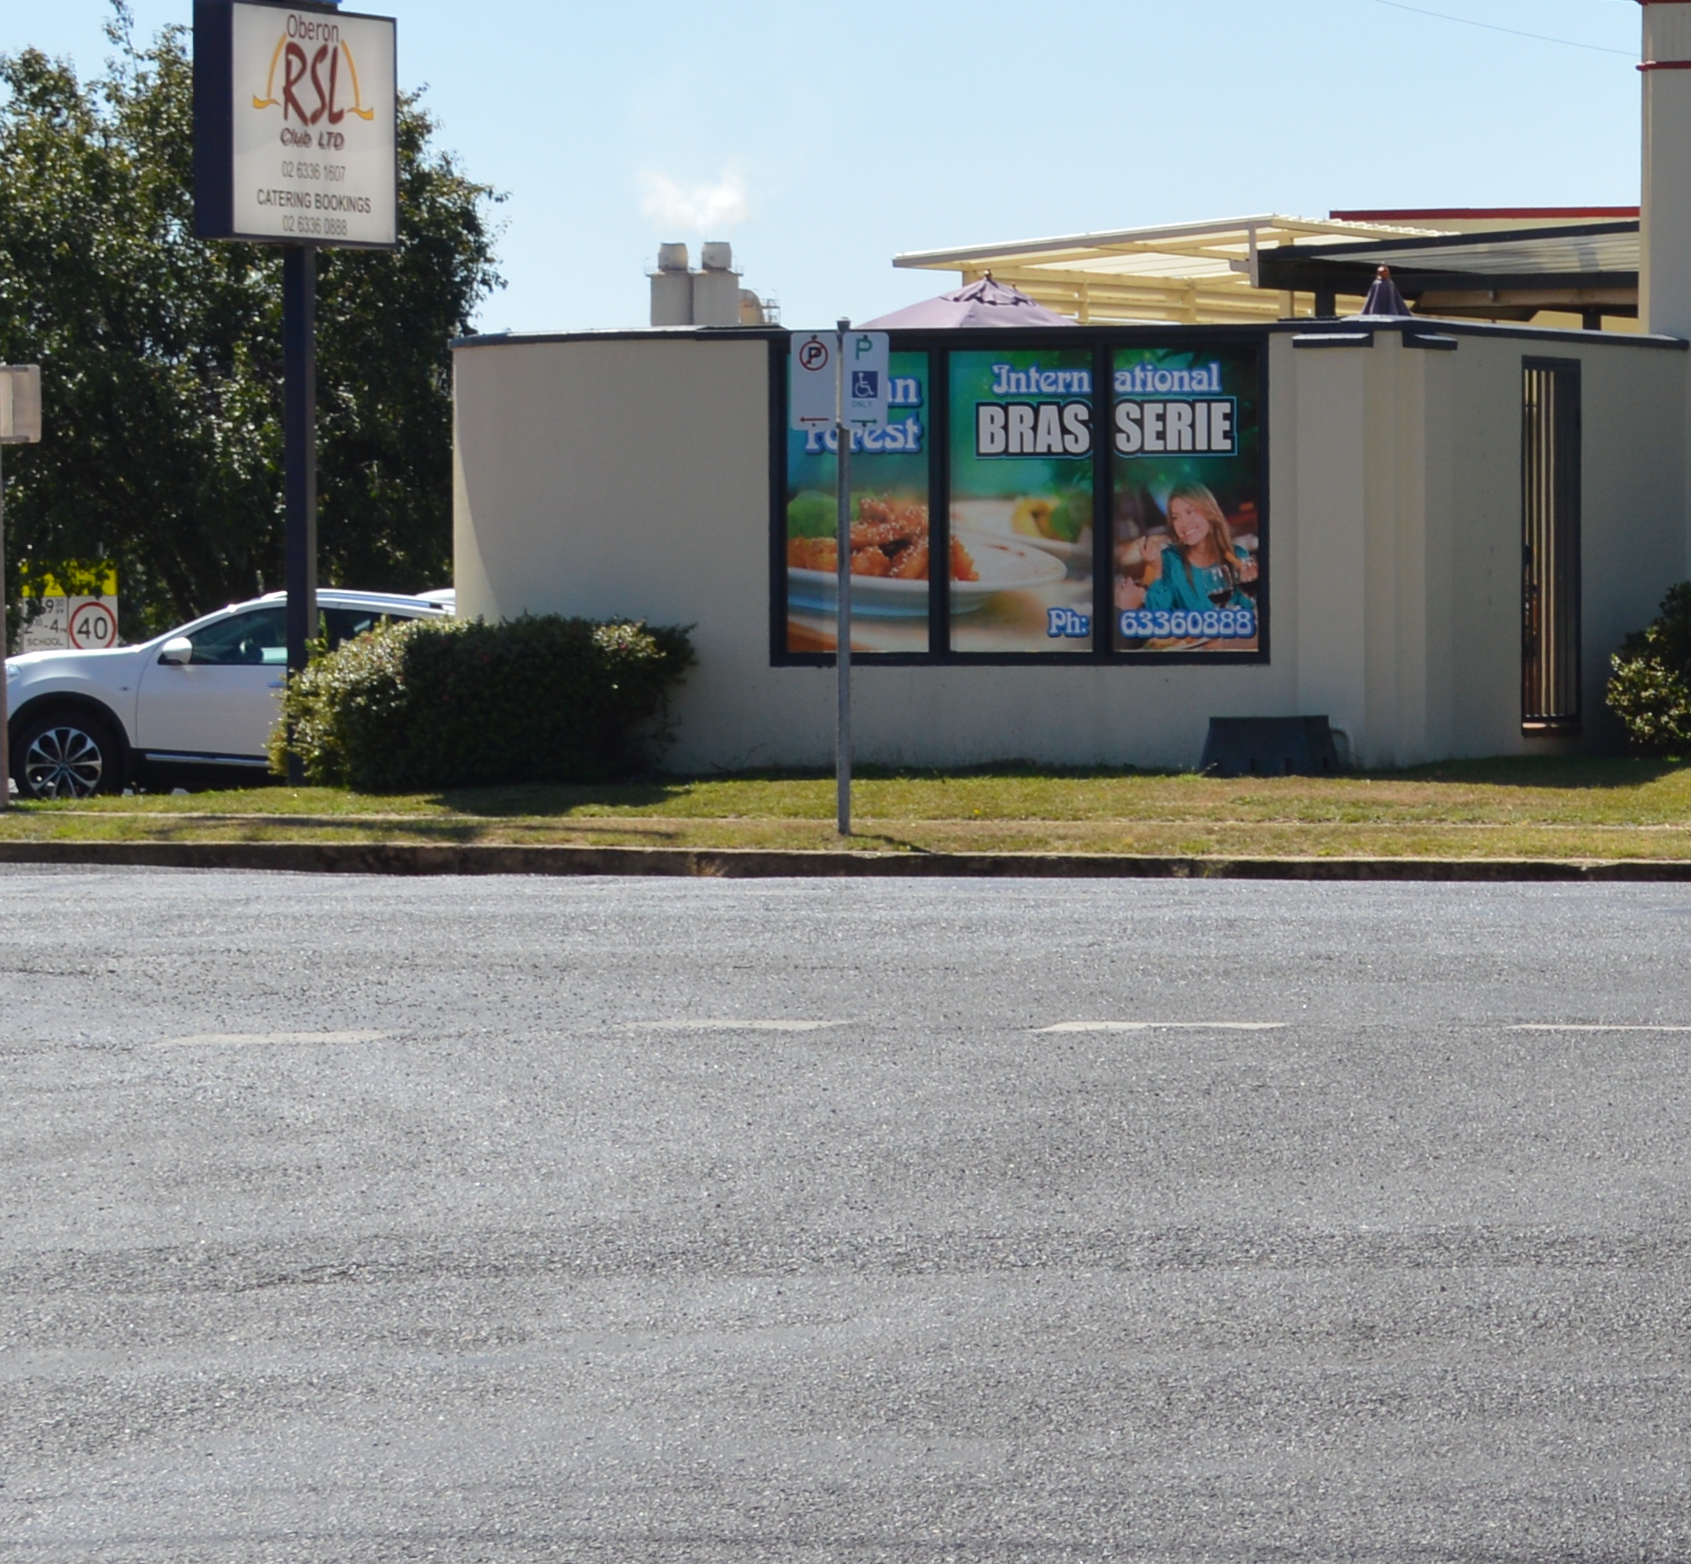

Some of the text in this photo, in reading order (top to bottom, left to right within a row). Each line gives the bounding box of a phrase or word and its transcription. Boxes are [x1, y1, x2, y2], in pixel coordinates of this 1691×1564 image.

[286, 14, 340, 44] Oberon
[282, 41, 345, 127] RSL
[280, 127, 346, 152] Club LTD
[281, 161, 346, 183] 02 6336 1607
[257, 188, 371, 215] CATERING BOOKINGS
[282, 215, 295, 233] 02
[855, 338, 873, 361] P
[77, 616, 108, 640] 40
[1049, 610, 1253, 636] Ph: 63360888
[27, 638, 64, 647] SCHOOL
